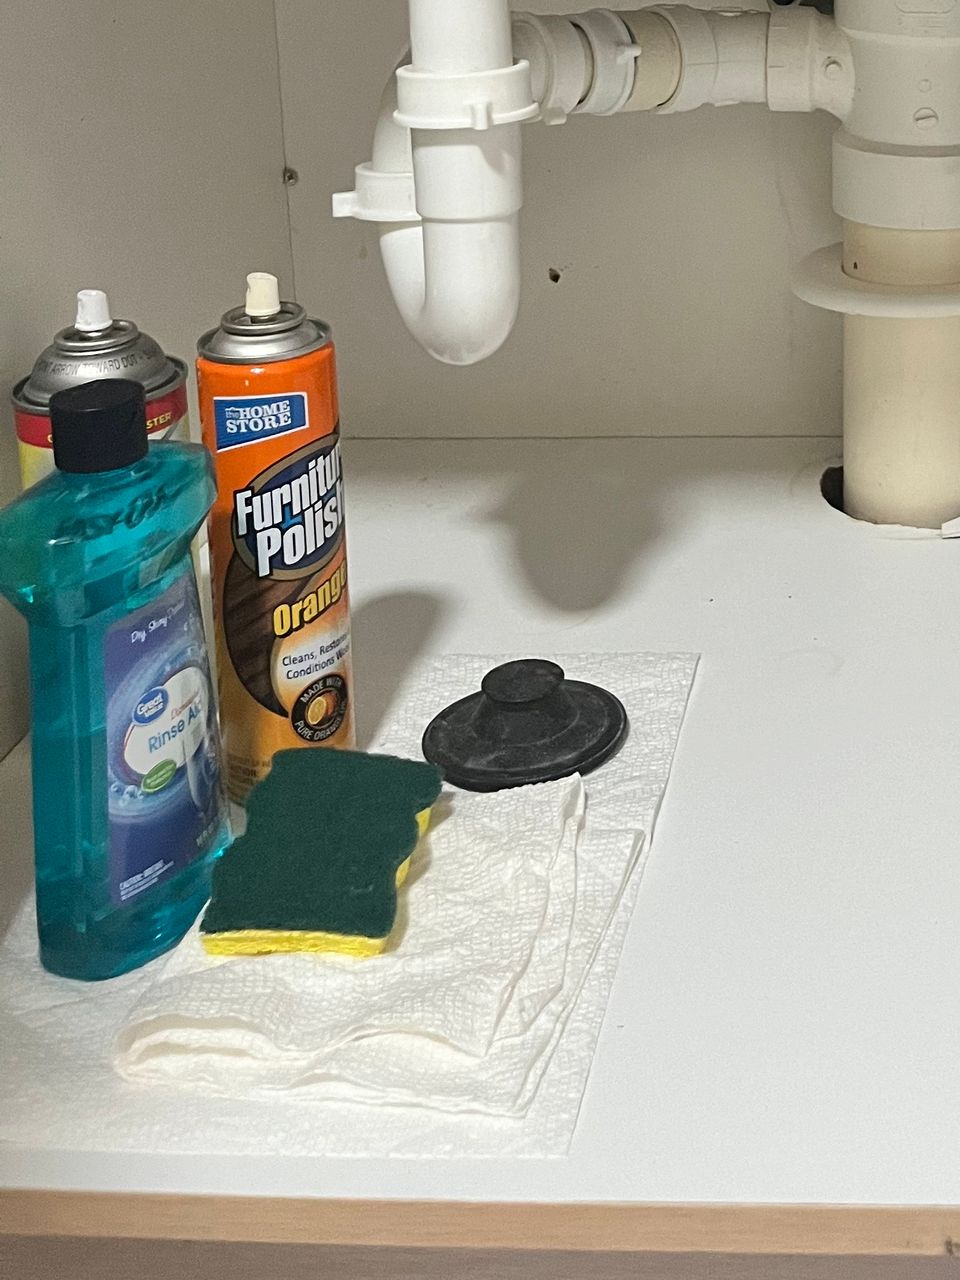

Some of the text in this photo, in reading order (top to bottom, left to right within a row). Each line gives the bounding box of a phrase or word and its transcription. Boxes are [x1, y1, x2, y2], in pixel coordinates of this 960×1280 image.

[238, 400, 291, 420] HOME
[226, 412, 292, 434] STORE
[282, 650, 317, 667] Cleans,
[286, 656, 335, 680] Conditions
[300, 679, 325, 703] MADE
[147, 719, 185, 754] Rinse
[294, 720, 314, 739] PURE
